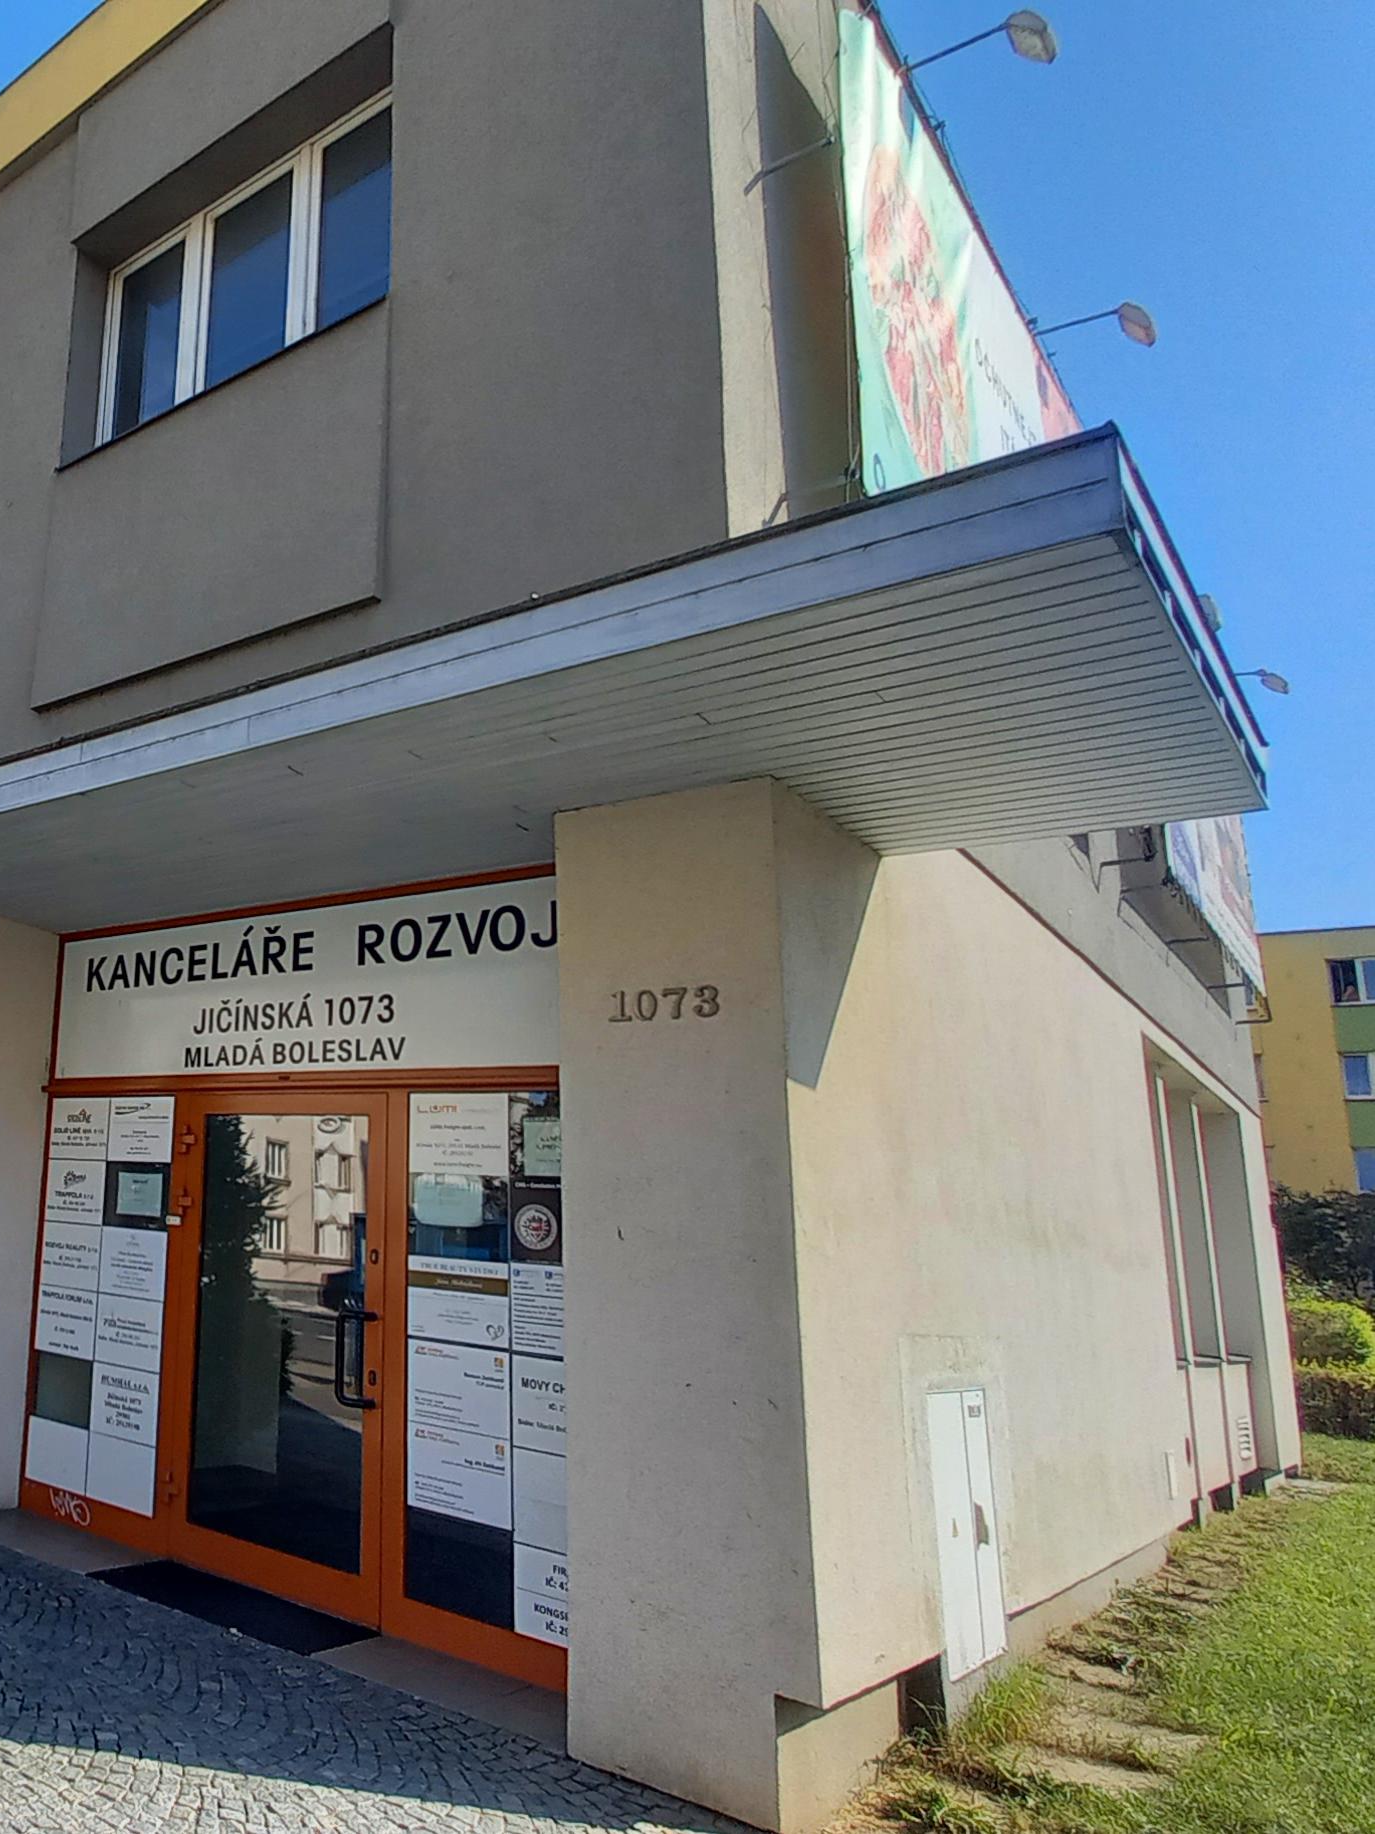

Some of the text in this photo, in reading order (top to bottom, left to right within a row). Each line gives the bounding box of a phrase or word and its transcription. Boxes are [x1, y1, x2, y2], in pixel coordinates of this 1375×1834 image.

[86, 900, 558, 993] KANCELÁŘE ROZVOJ
[193, 992, 395, 1035] JIČÍNSKÁ 1073
[608, 984, 721, 1022] 1073
[184, 1036, 406, 1068] MLADÁ BOLESLAV
[520, 1376, 551, 1392] MOVY
